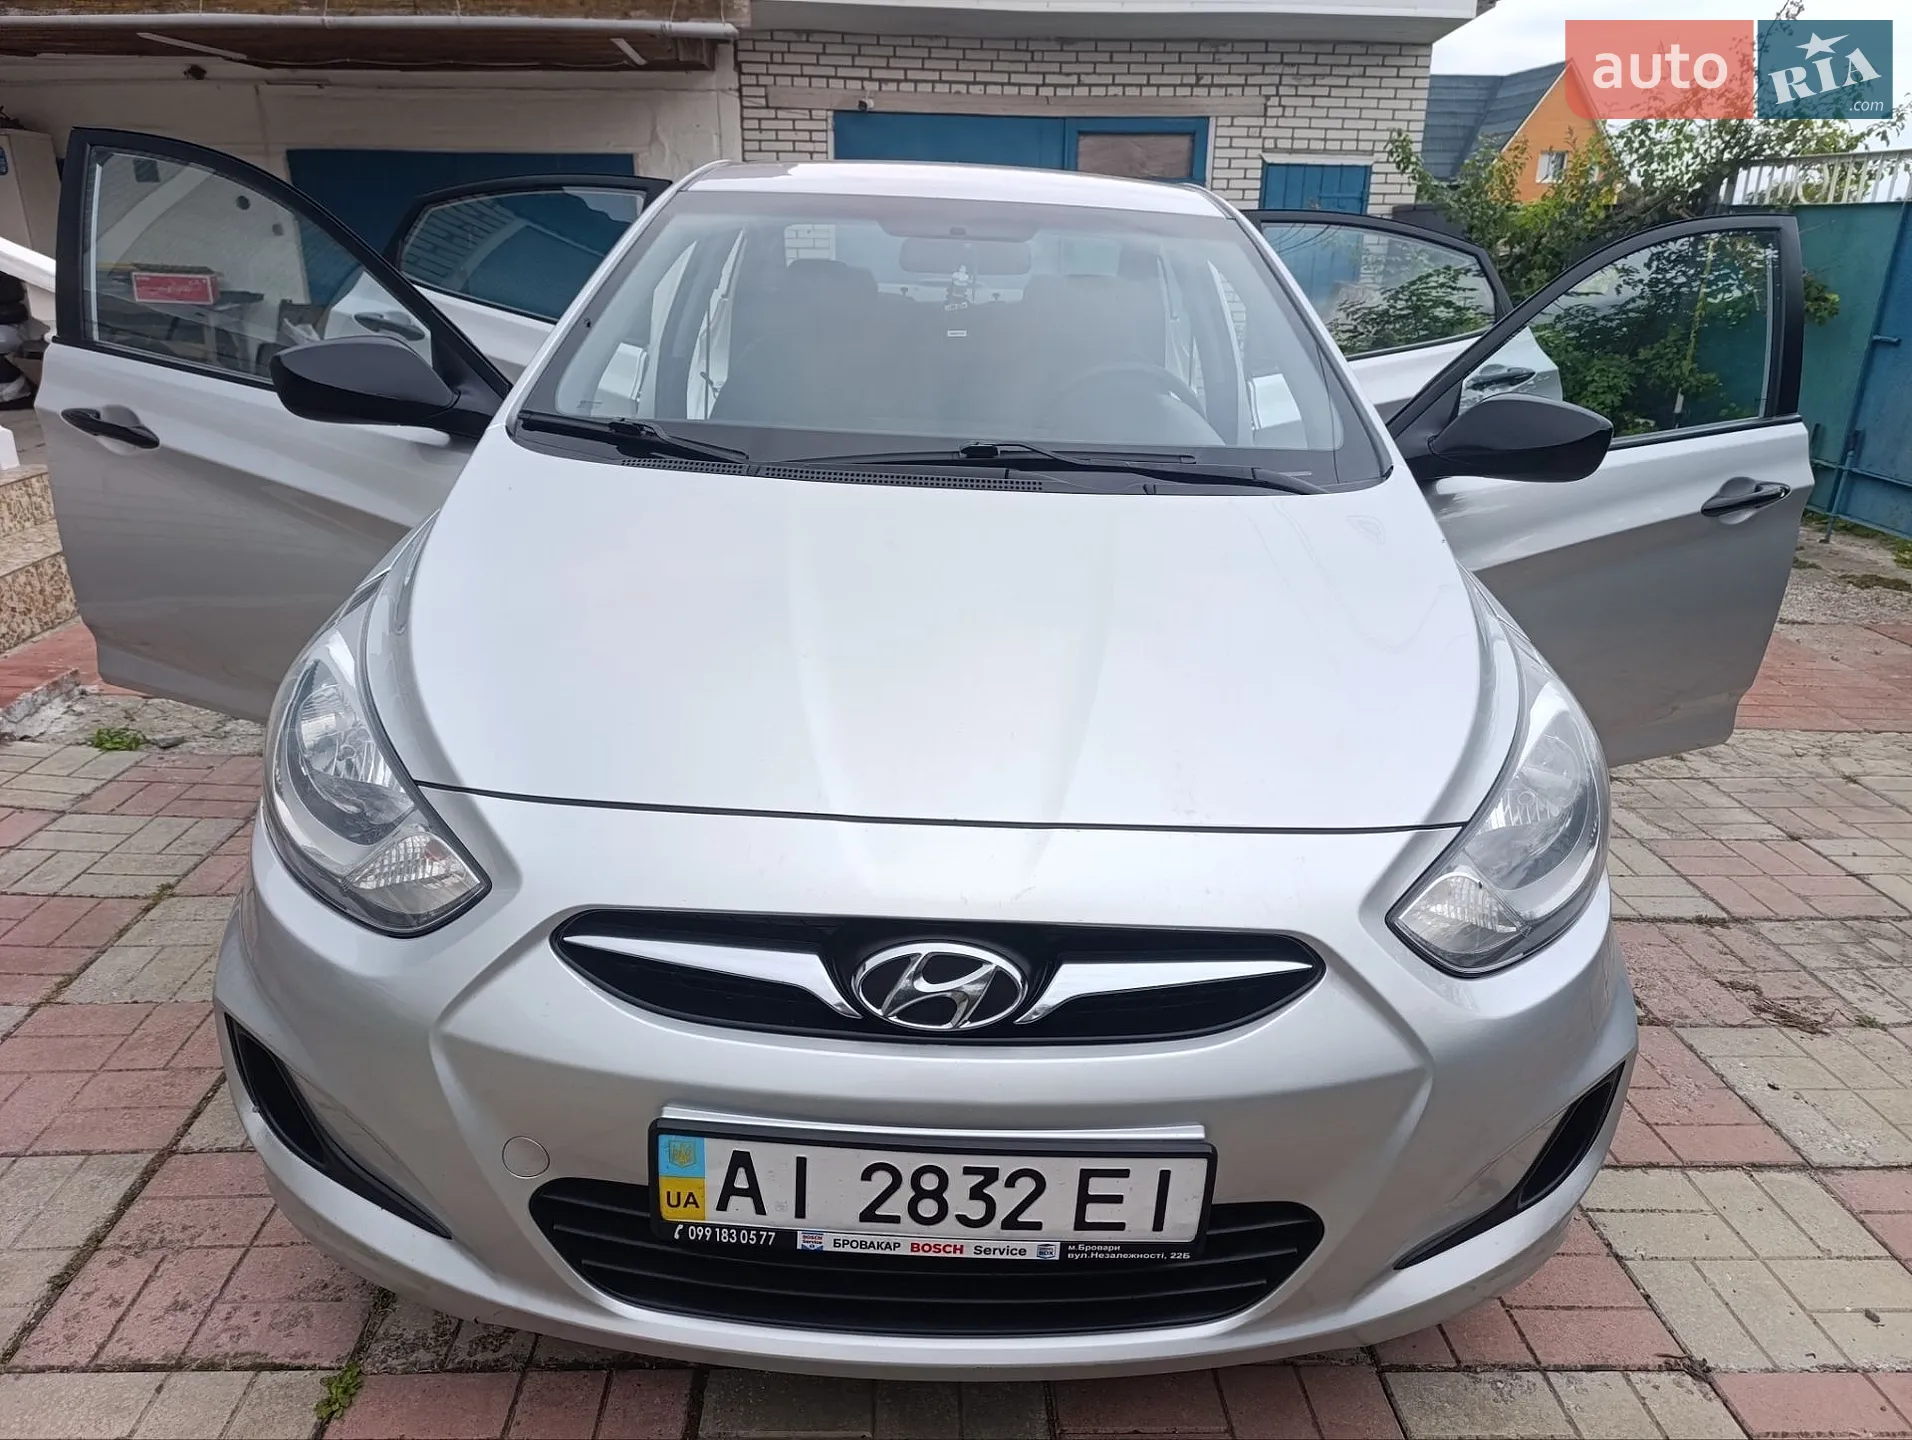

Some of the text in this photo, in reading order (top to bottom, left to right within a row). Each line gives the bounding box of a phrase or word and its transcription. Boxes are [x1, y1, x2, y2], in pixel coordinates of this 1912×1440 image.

[666, 1191, 700, 1209] UA
[715, 1150, 1171, 1232] AI 2832 EI
[688, 1225, 712, 1240] 099
[715, 1228, 737, 1243] 183
[833, 1238, 1028, 1256] БРОВАКАР BOSCH Service
